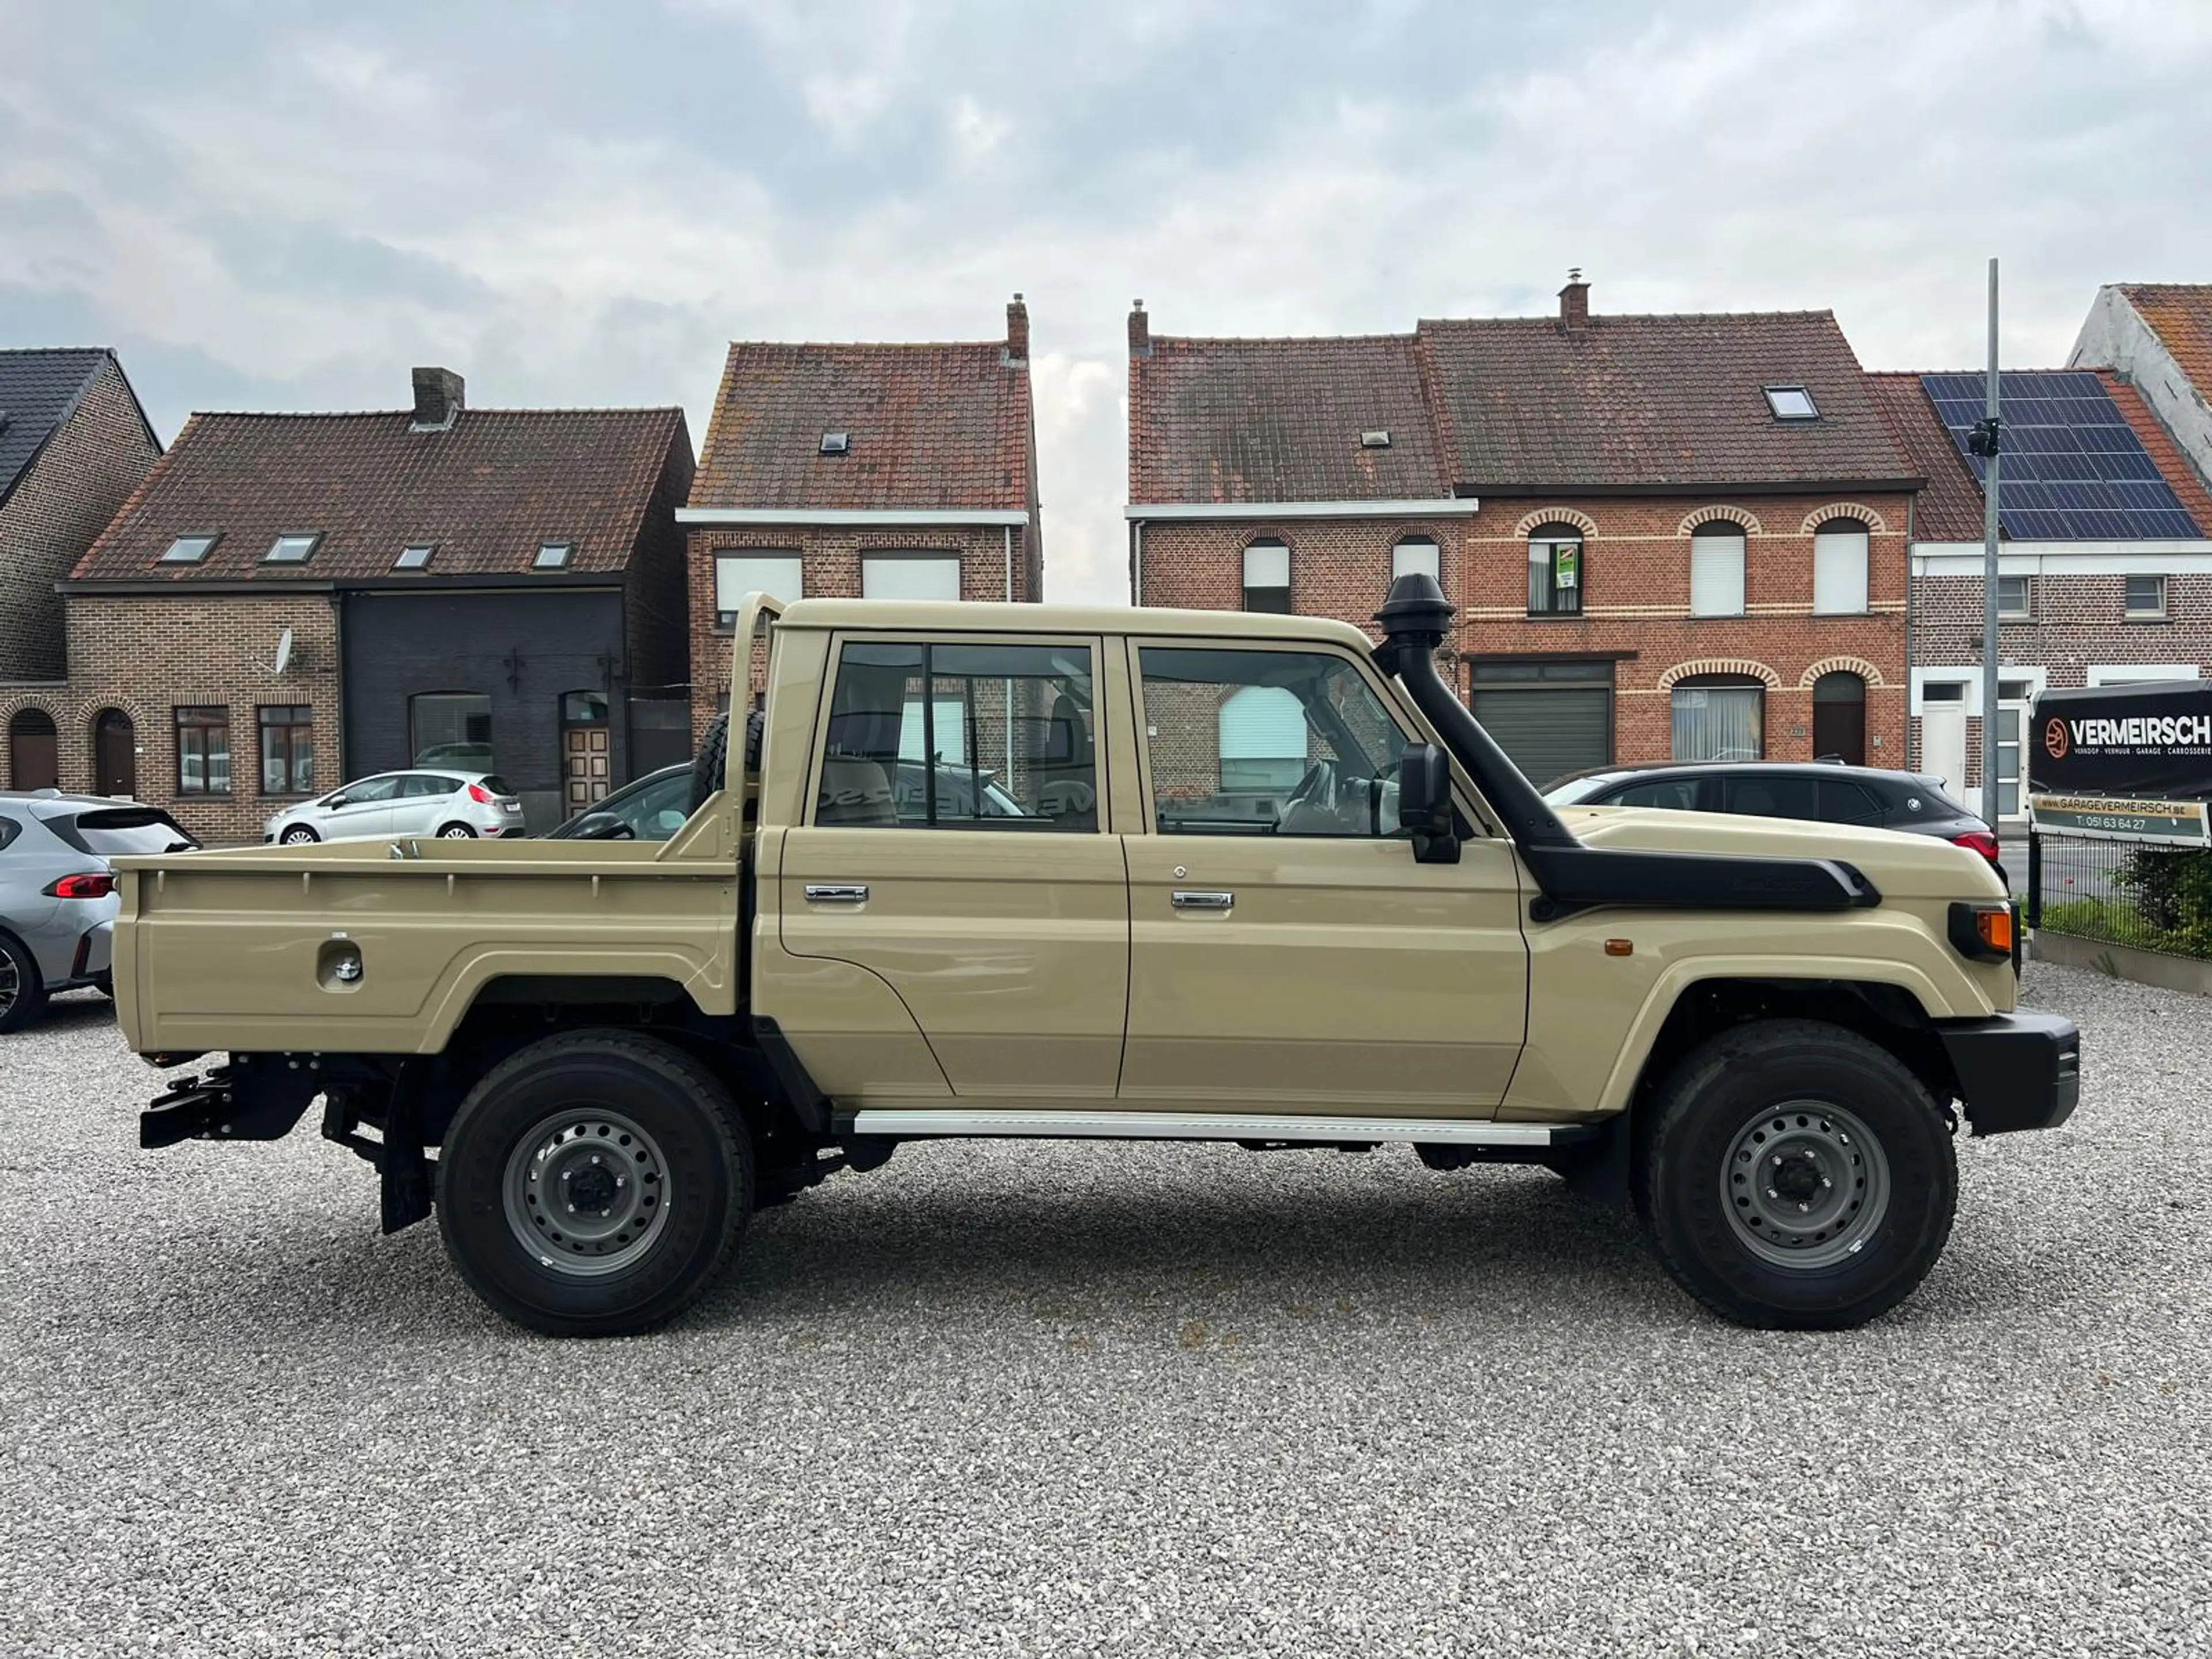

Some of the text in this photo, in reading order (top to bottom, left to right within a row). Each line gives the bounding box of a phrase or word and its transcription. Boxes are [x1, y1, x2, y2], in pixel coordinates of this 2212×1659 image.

[2070, 715, 2211, 745] VERMEIRSCH
[2075, 815, 2145, 830] T: 051 63 64 27
